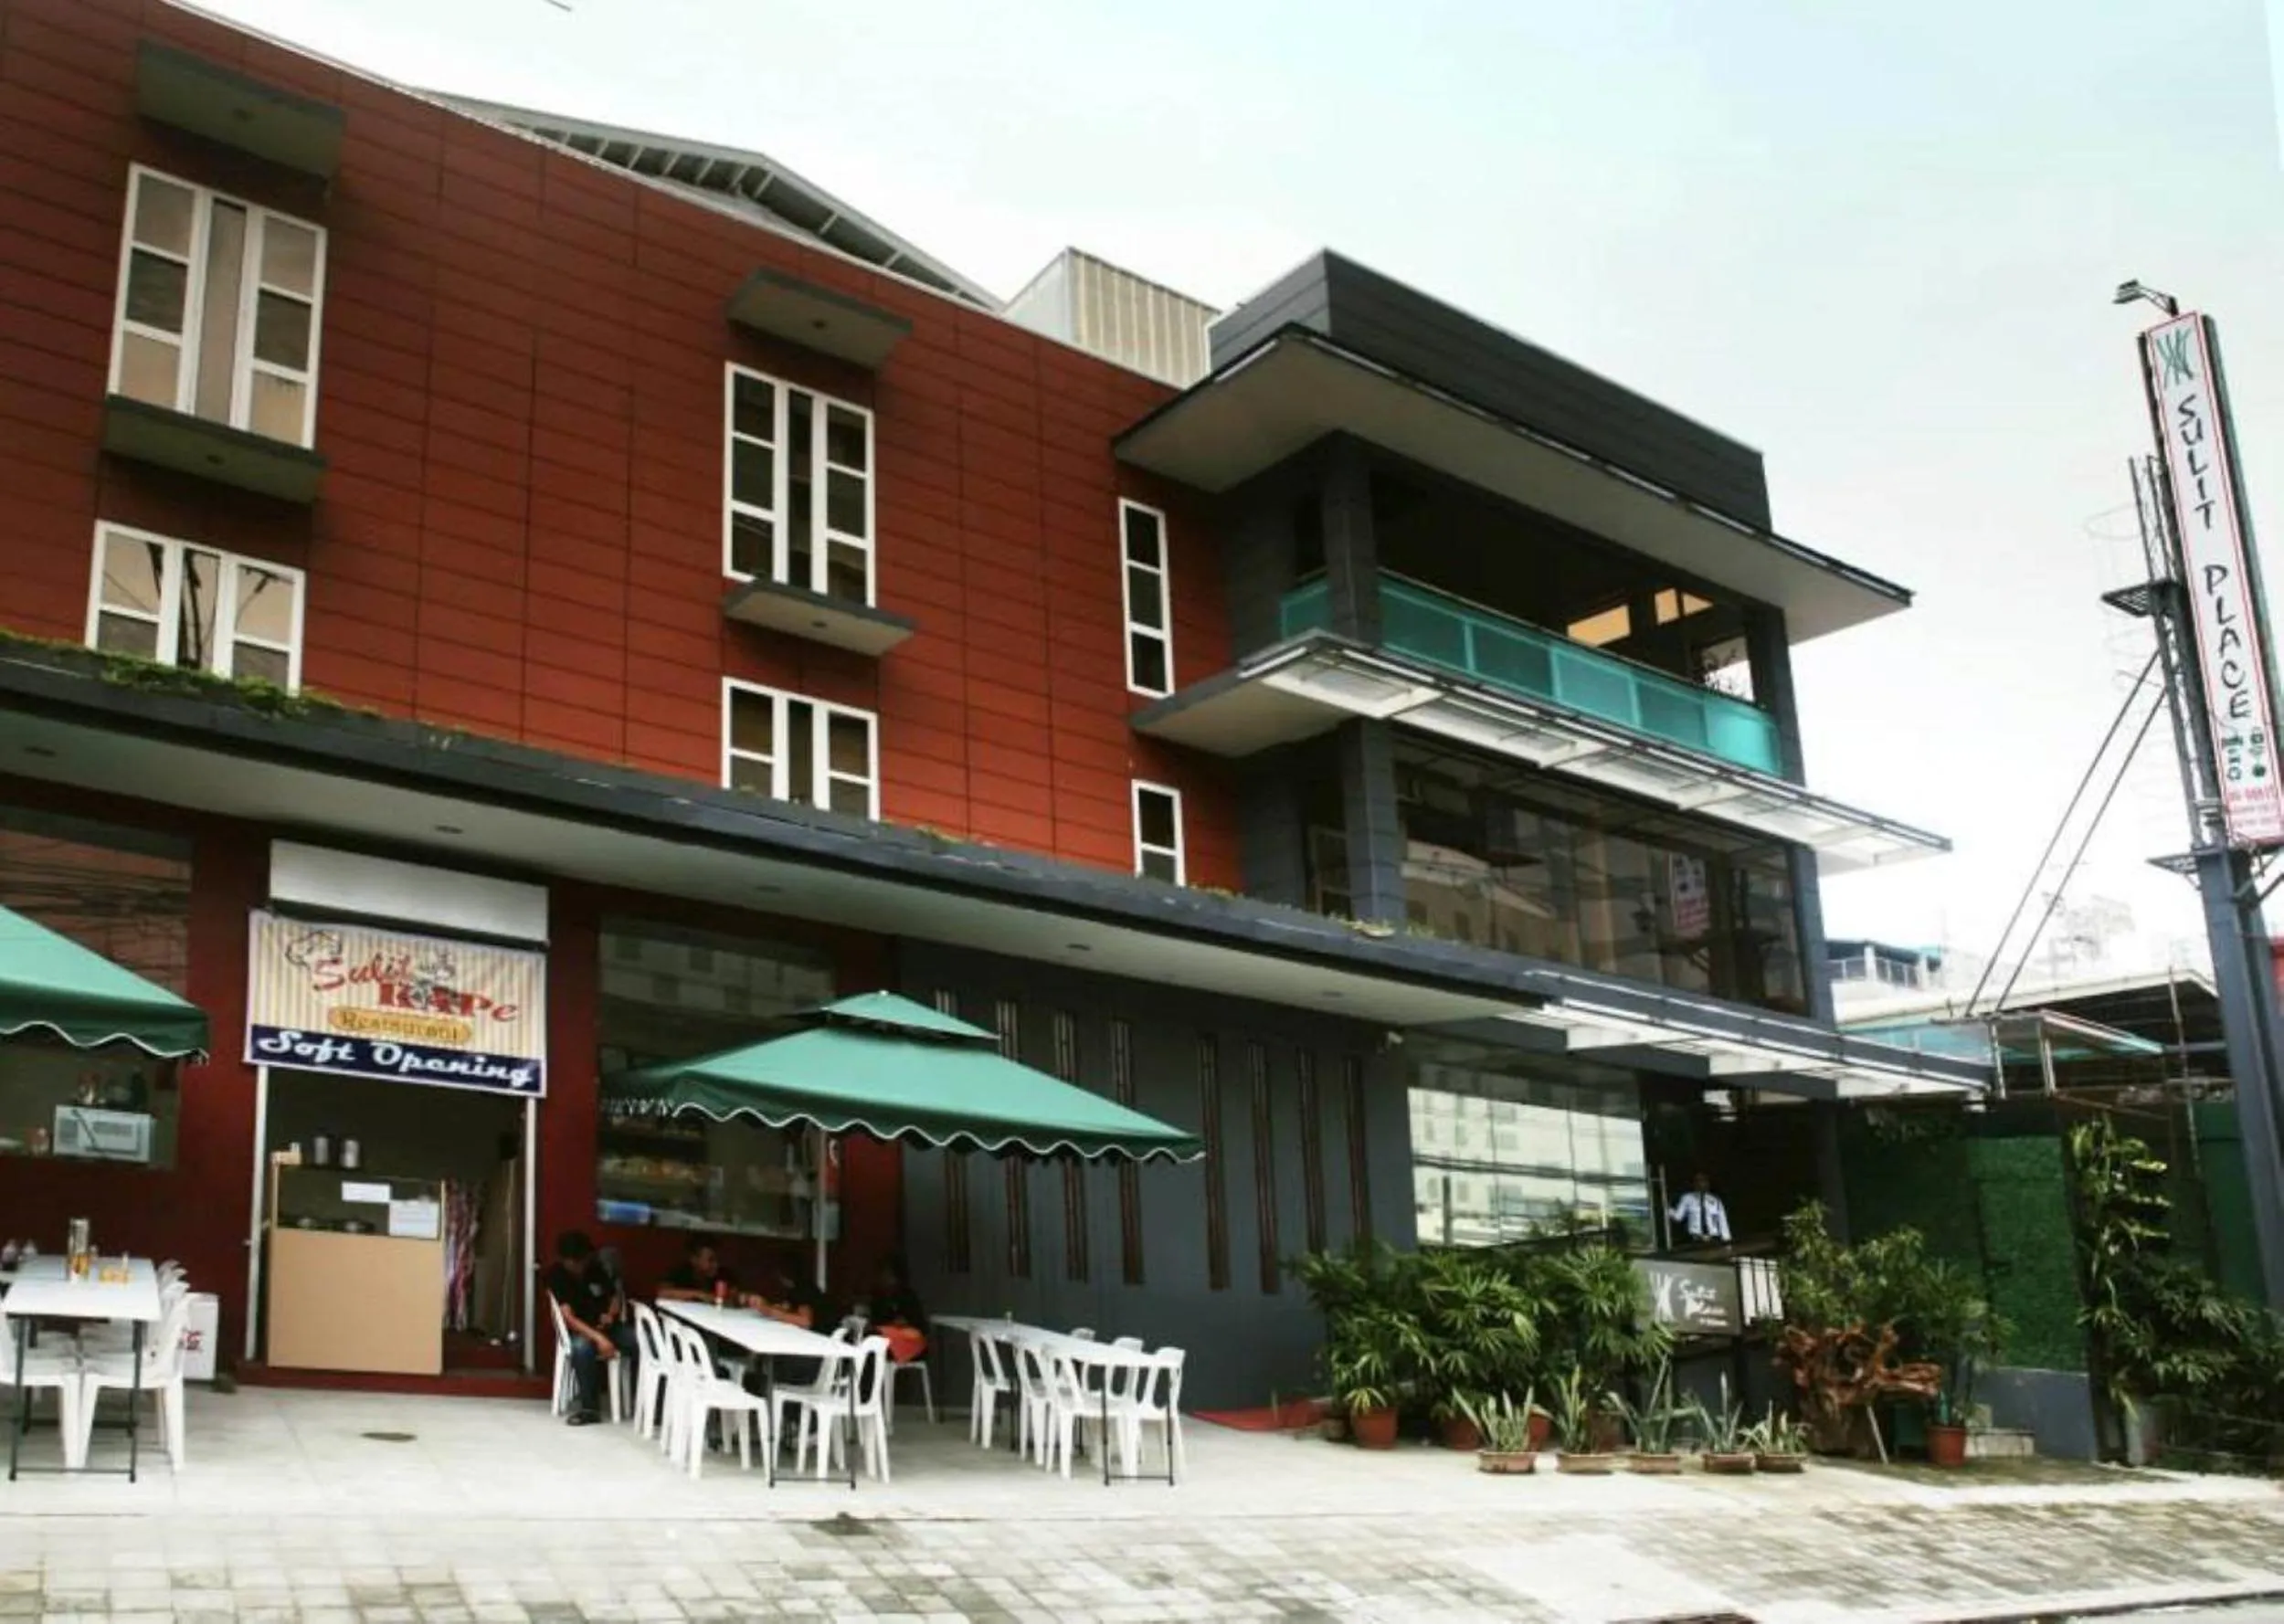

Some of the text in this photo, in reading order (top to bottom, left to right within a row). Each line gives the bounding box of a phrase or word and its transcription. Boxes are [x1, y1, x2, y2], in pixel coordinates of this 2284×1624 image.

[2177, 393, 2215, 531] SULIT
[2203, 563, 2252, 719] PLACE
[257, 1030, 534, 1087] Soft Opening
